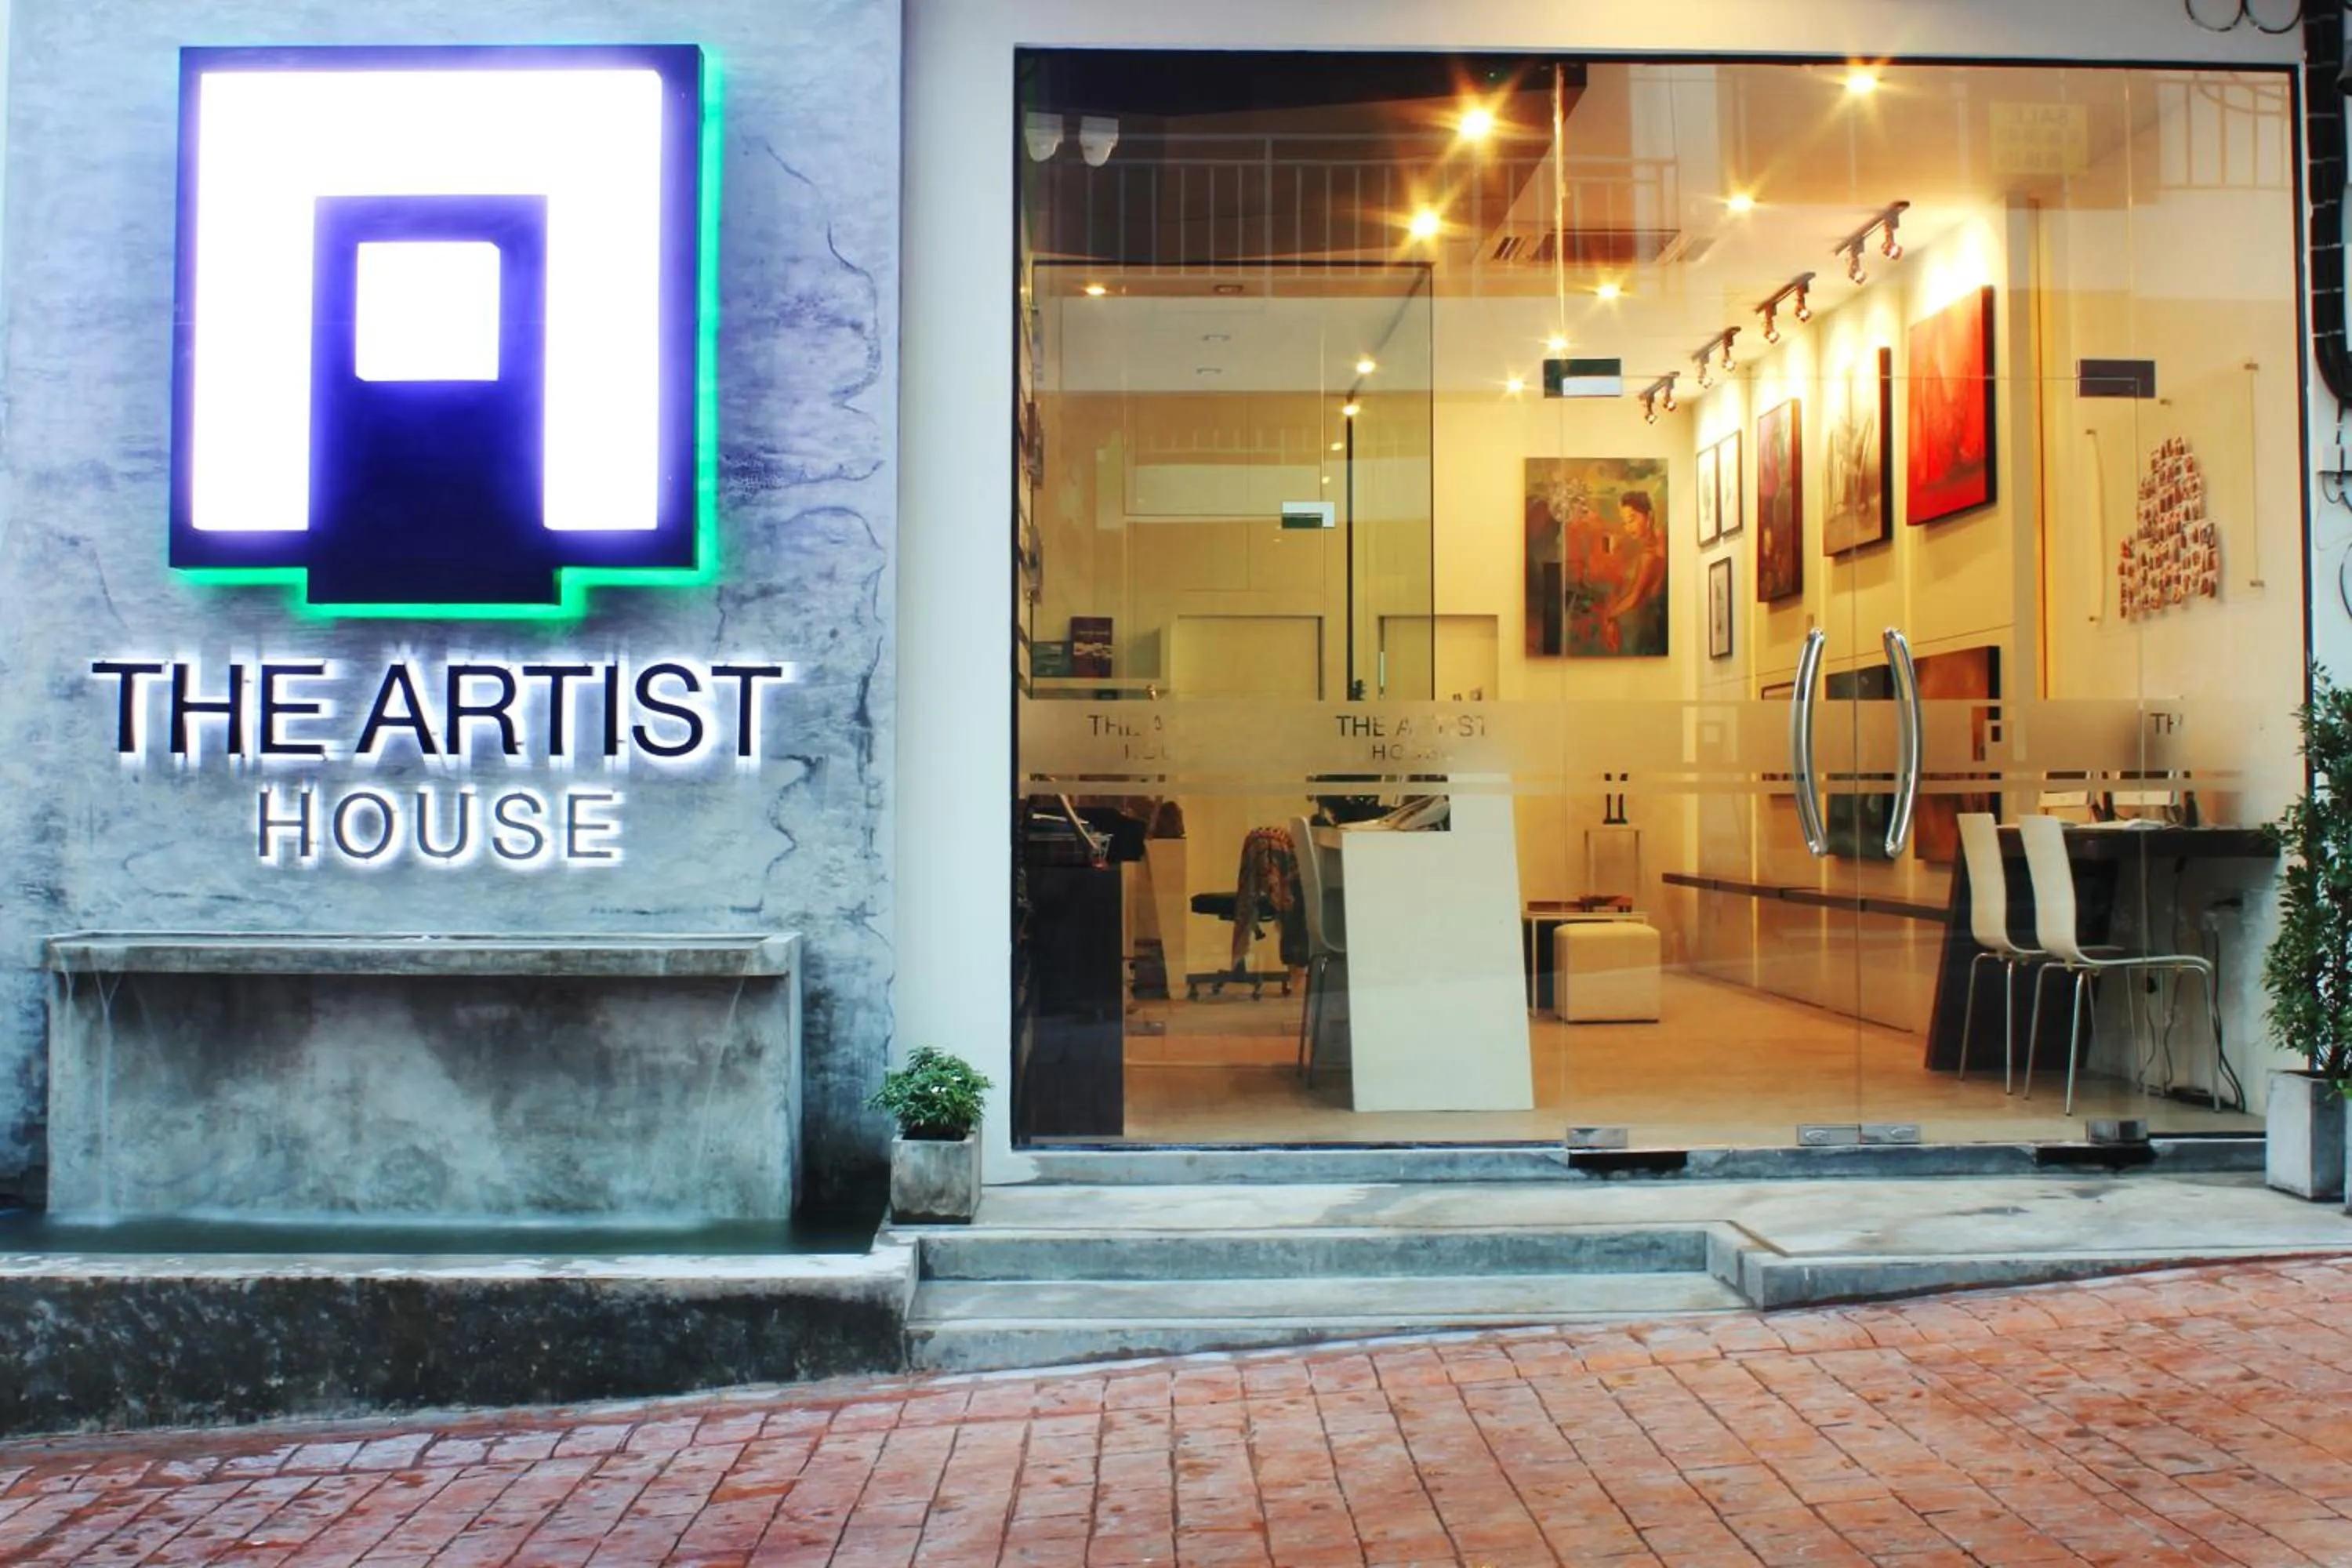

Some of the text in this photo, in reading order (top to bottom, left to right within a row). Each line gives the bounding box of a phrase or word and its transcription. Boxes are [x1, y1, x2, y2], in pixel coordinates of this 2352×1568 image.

[92, 662, 782, 757] THE ARTIST
[1335, 714, 1385, 738] THE
[259, 792, 619, 859] HOUSE
